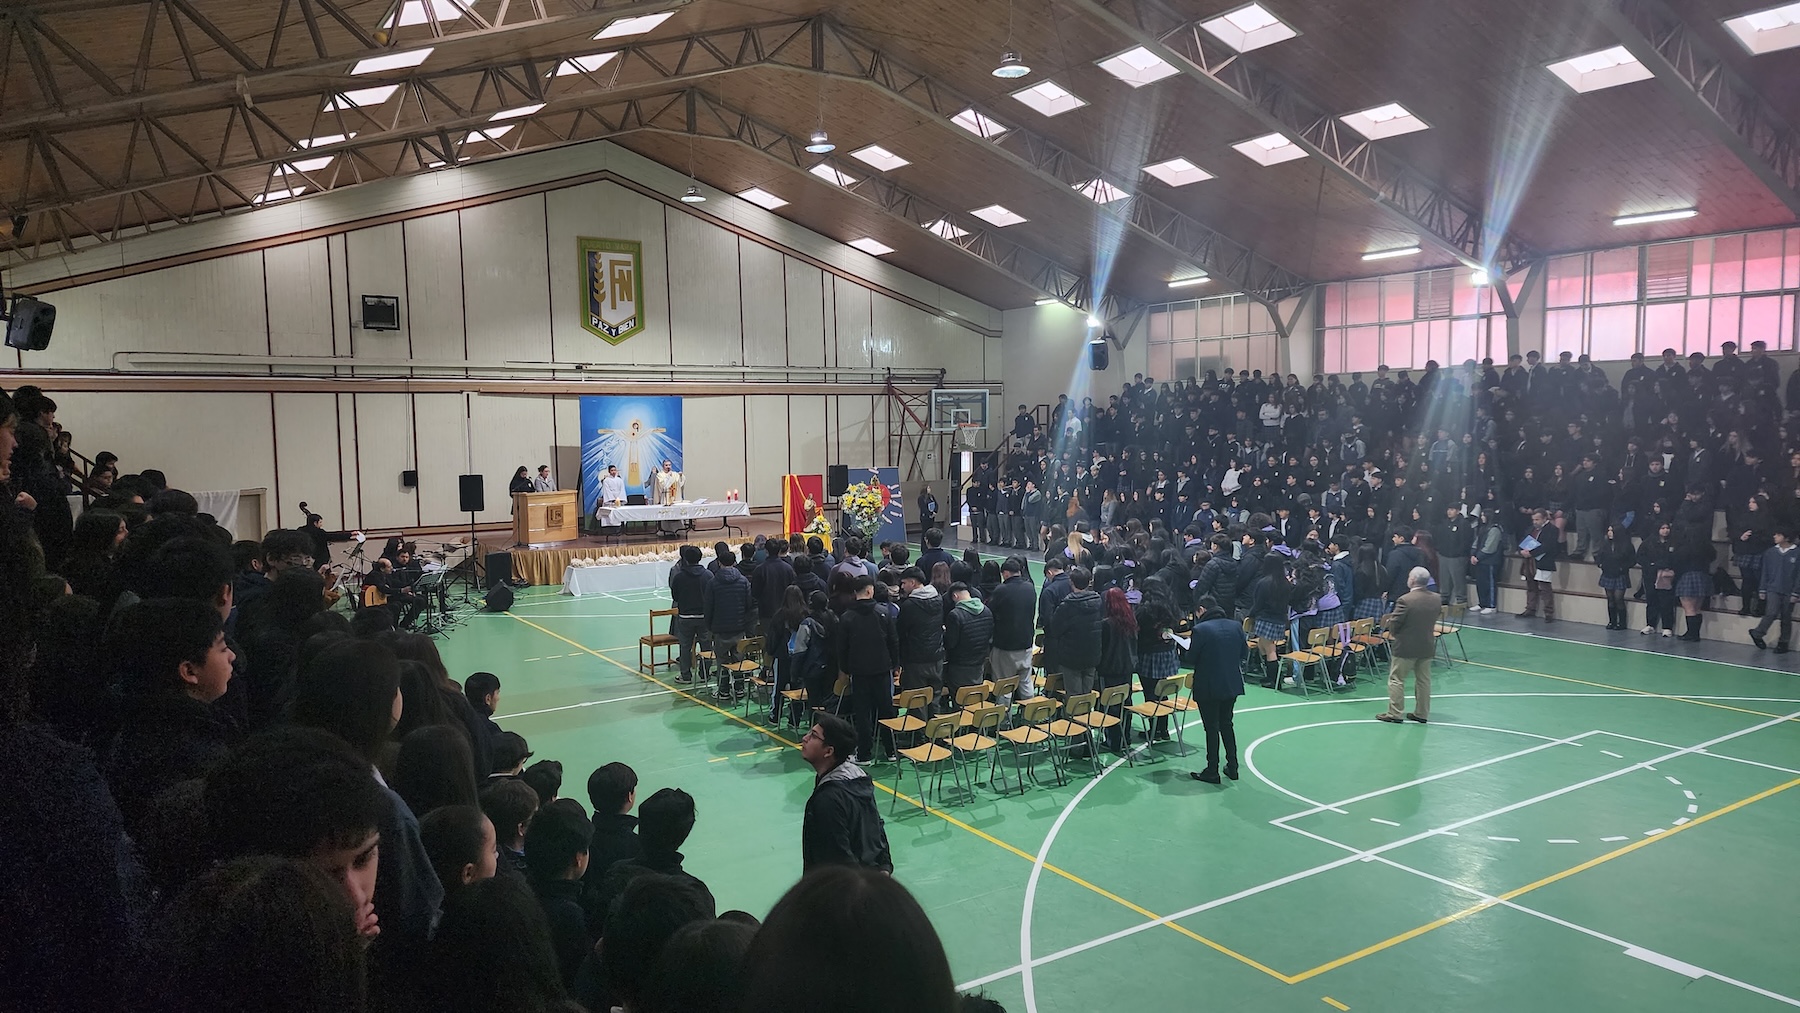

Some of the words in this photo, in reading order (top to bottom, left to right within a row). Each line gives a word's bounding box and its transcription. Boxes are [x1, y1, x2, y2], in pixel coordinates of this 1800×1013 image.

[609, 259, 633, 310] FN
[592, 317, 610, 334] PAZ
[611, 328, 617, 336] Y
[618, 318, 635, 334] BIEN
